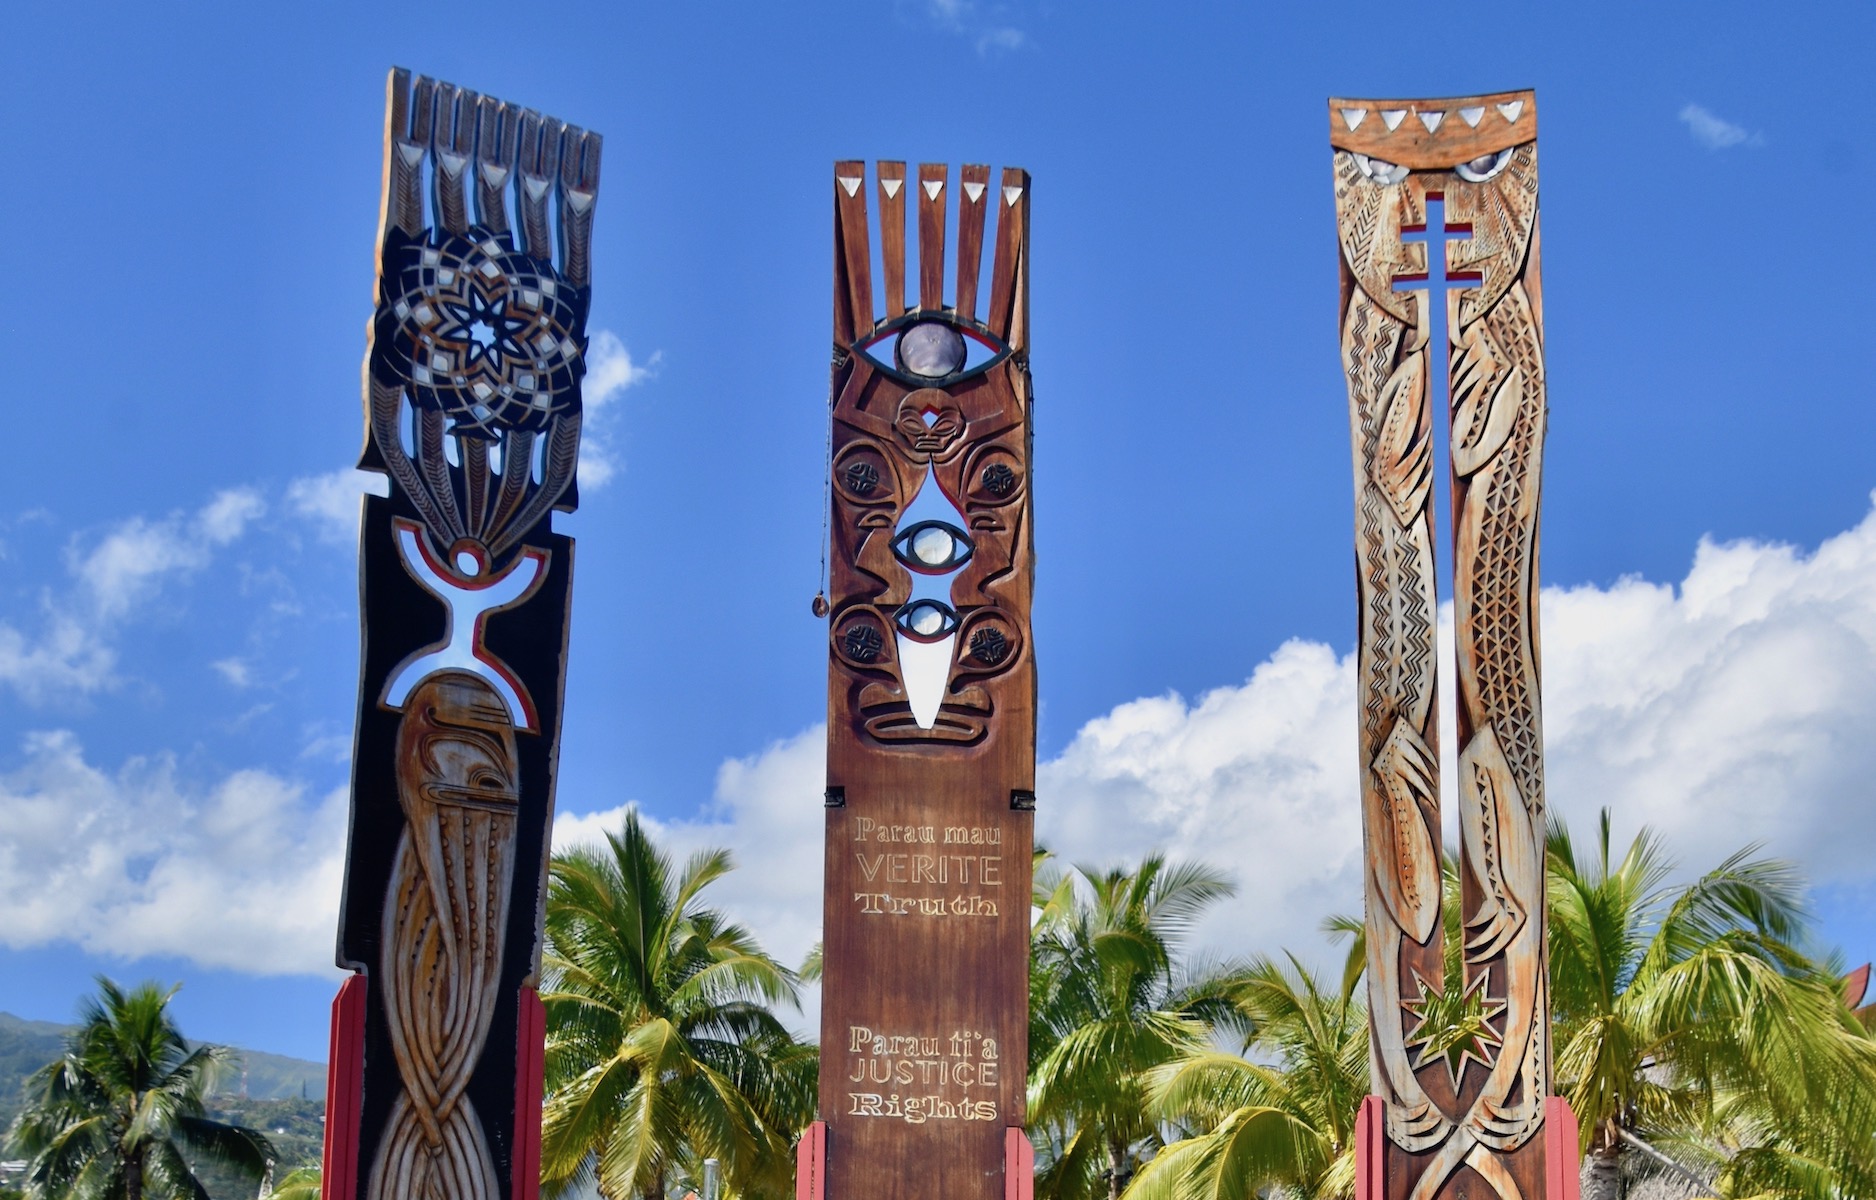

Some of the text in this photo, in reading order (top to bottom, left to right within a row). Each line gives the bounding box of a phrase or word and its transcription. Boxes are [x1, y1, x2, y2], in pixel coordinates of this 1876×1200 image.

[854, 816, 1002, 845] Parau mau
[855, 853, 1003, 886] VERITE
[854, 892, 999, 917] Truth
[849, 1026, 940, 1056] Parau
[849, 1058, 998, 1087] JUSTICE
[848, 1092, 998, 1124] Rights
